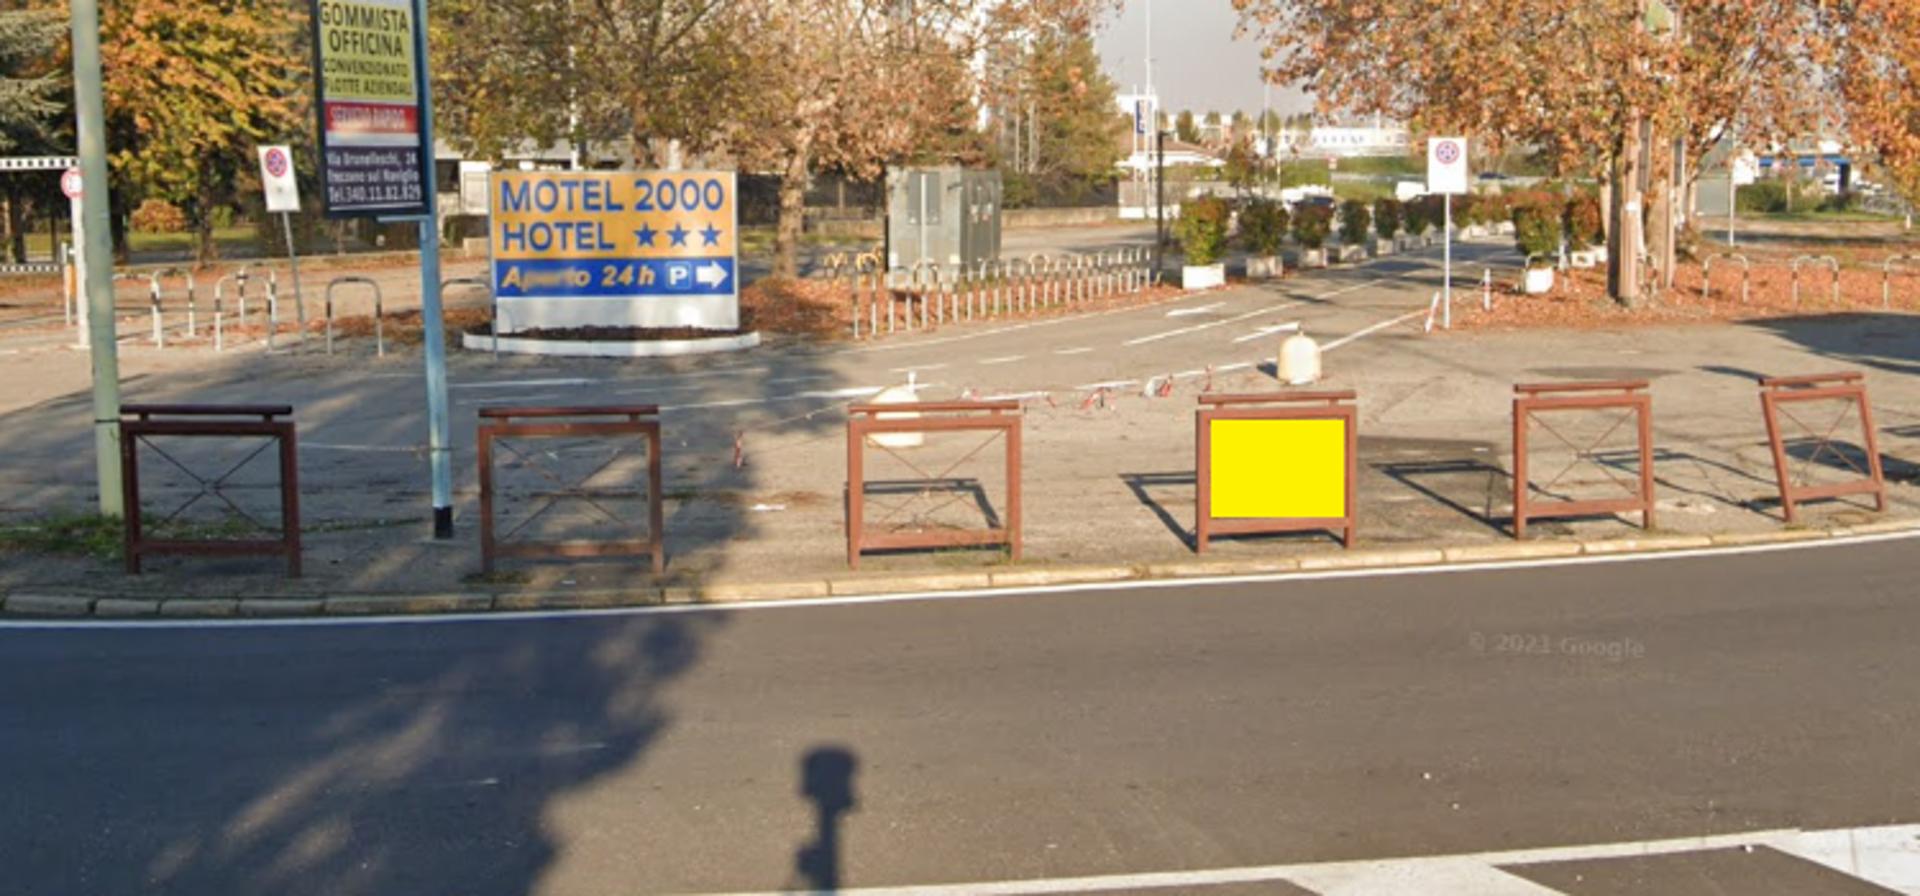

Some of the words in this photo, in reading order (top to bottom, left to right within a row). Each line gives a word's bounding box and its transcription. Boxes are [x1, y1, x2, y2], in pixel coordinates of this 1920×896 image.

[319, 2, 409, 33] GOMMISTA
[329, 29, 404, 58] OFFICINA
[323, 58, 408, 78] CONVENZIONATO
[327, 152, 341, 166] Via
[501, 179, 624, 212] MOTEL
[634, 178, 724, 212] 2000
[502, 221, 615, 251] HOTEL
[601, 265, 634, 286] 24
[669, 266, 688, 286] P
